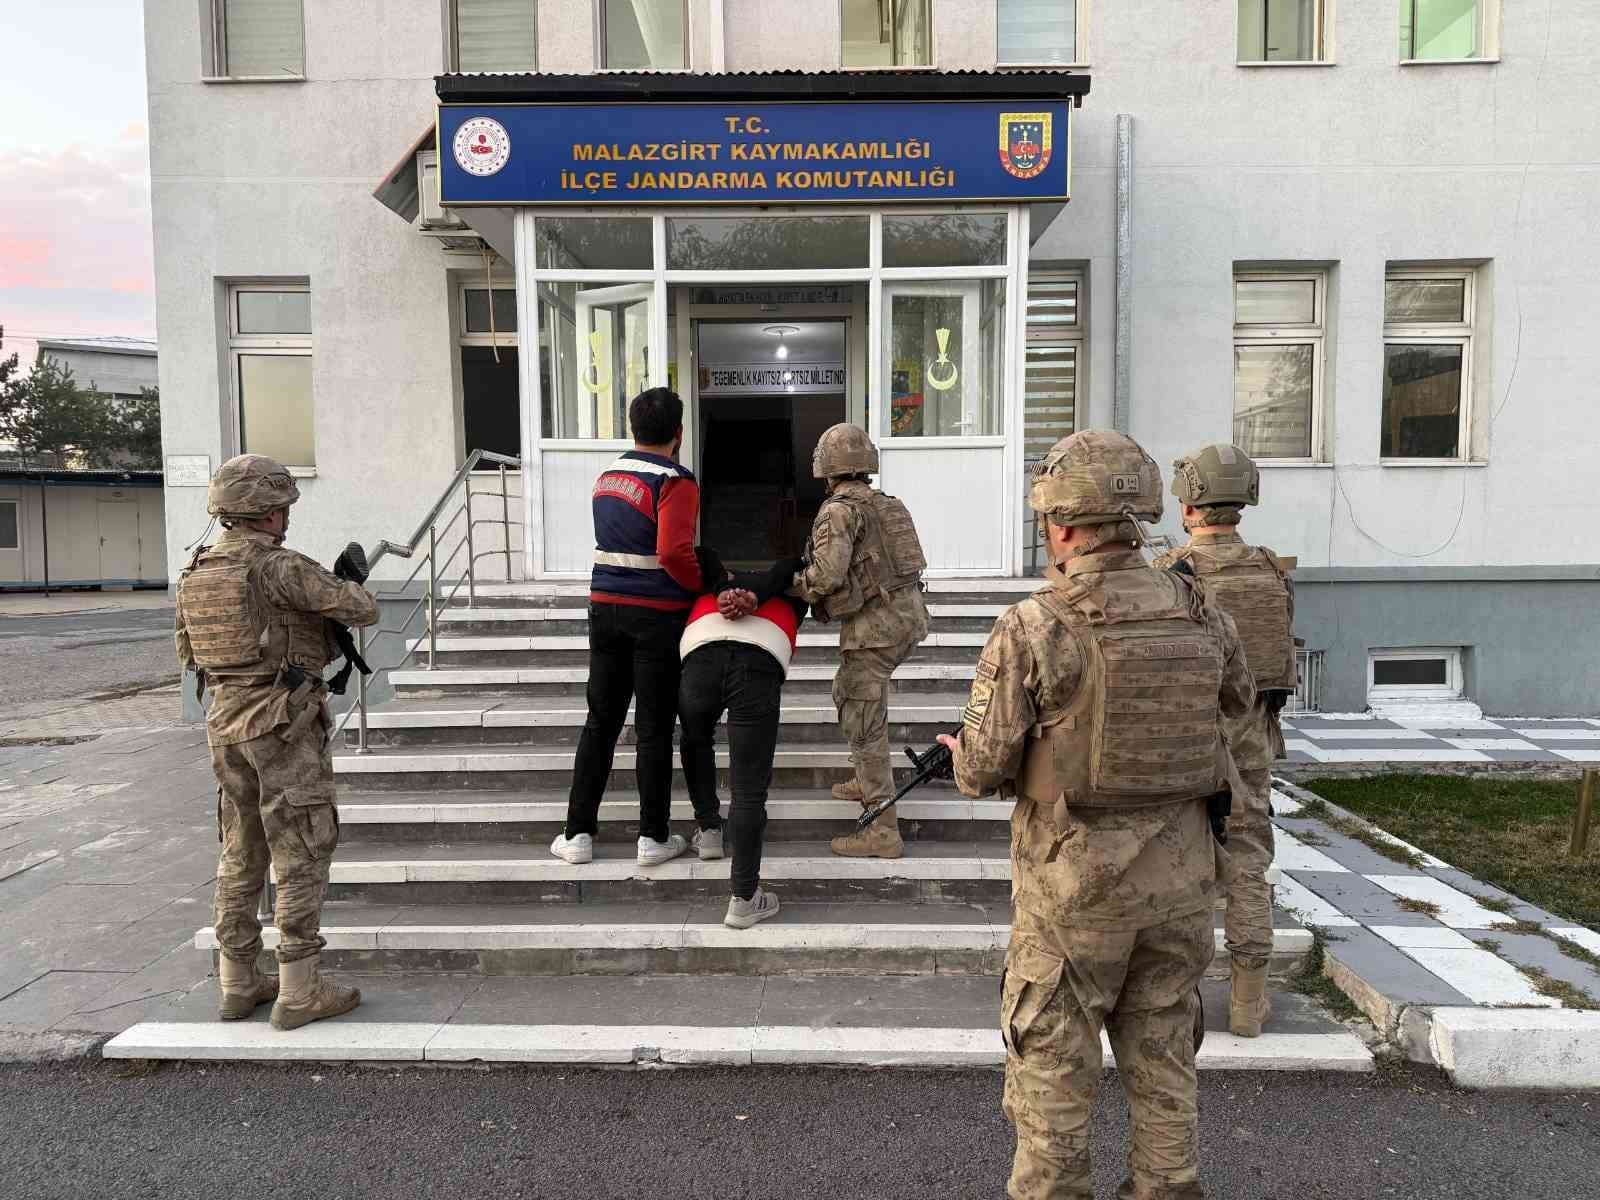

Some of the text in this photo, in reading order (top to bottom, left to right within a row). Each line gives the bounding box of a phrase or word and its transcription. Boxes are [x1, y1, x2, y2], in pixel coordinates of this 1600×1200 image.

[725, 116, 770, 133] T.C.
[572, 138, 931, 161] MALAZGİRT KAYMAKAMLIĞI
[560, 166, 955, 194] İLÇE JANDARMA KOMUTANLIĞI
